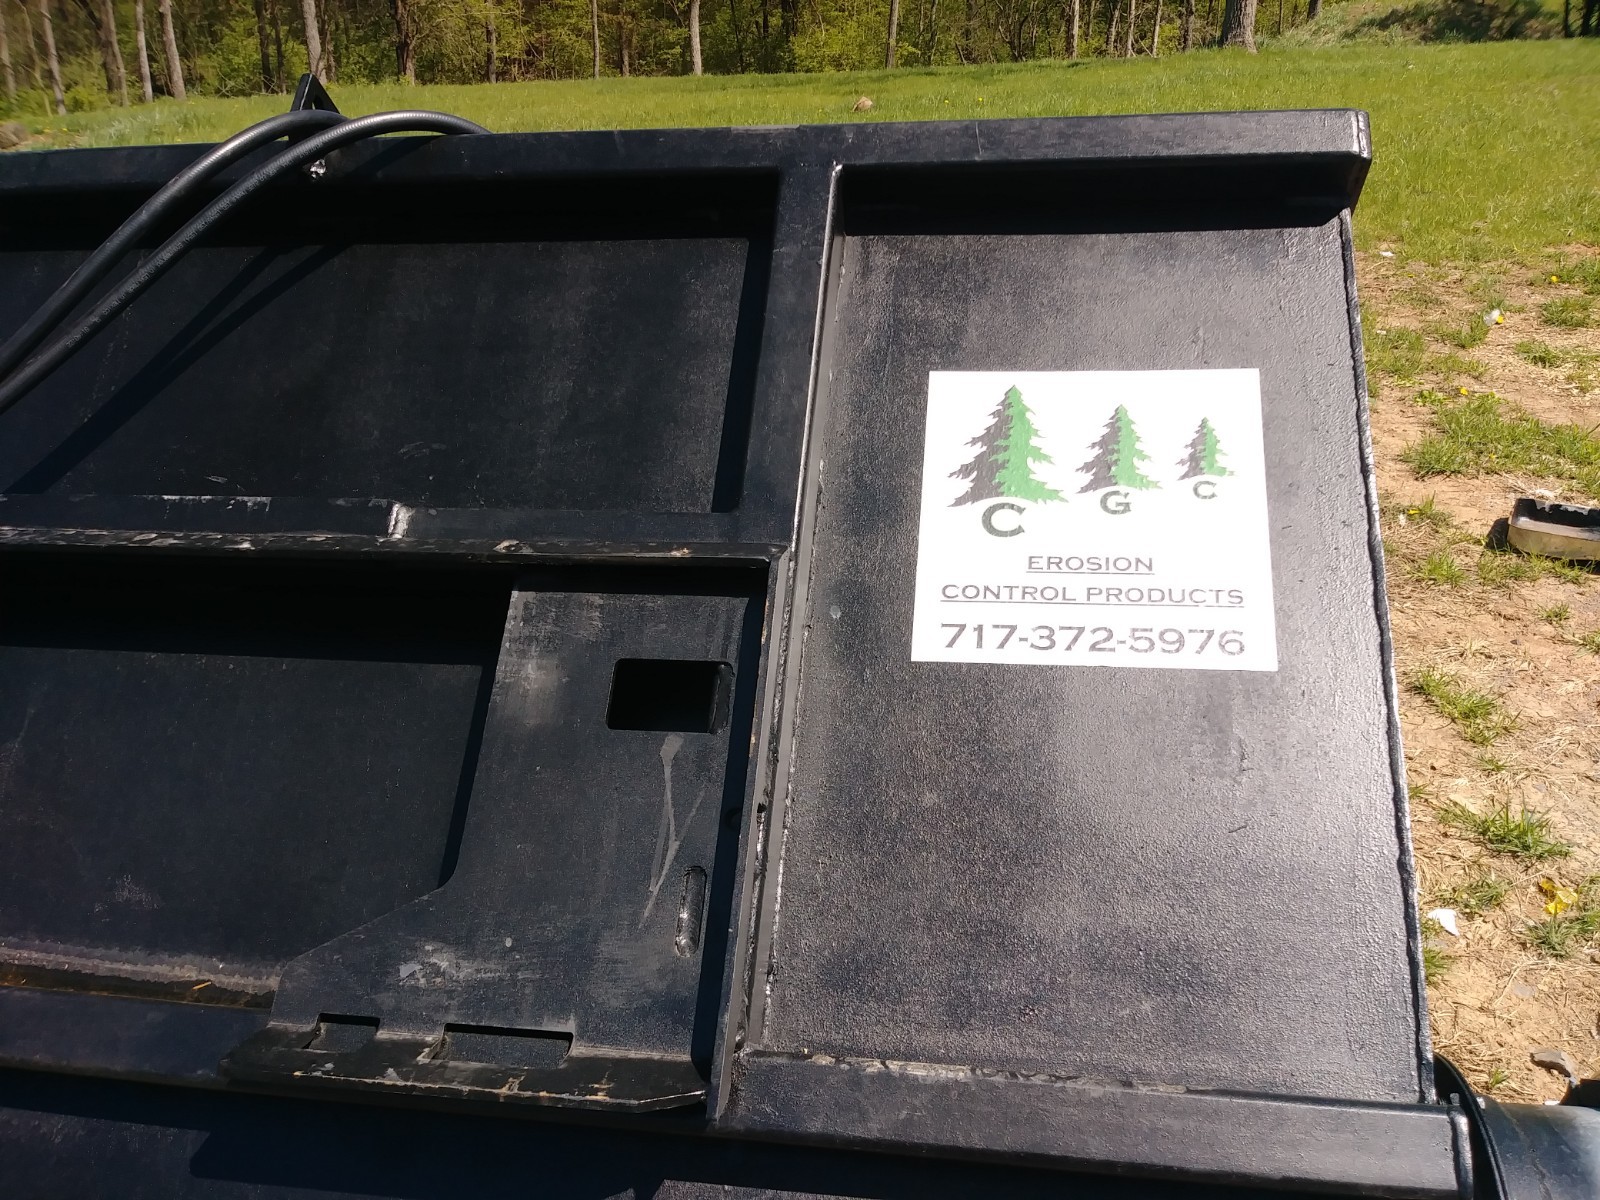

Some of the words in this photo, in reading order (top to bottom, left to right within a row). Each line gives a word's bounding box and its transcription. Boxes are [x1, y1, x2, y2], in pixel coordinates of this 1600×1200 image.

[981, 502, 1026, 537] C
[1099, 490, 1132, 515] G
[1192, 480, 1217, 499] C
[1026, 555, 1154, 572] EROSION
[941, 584, 1077, 602] CONTROL
[1085, 587, 1245, 605] PRODUCTS
[940, 622, 1246, 656] 717-372-5976
